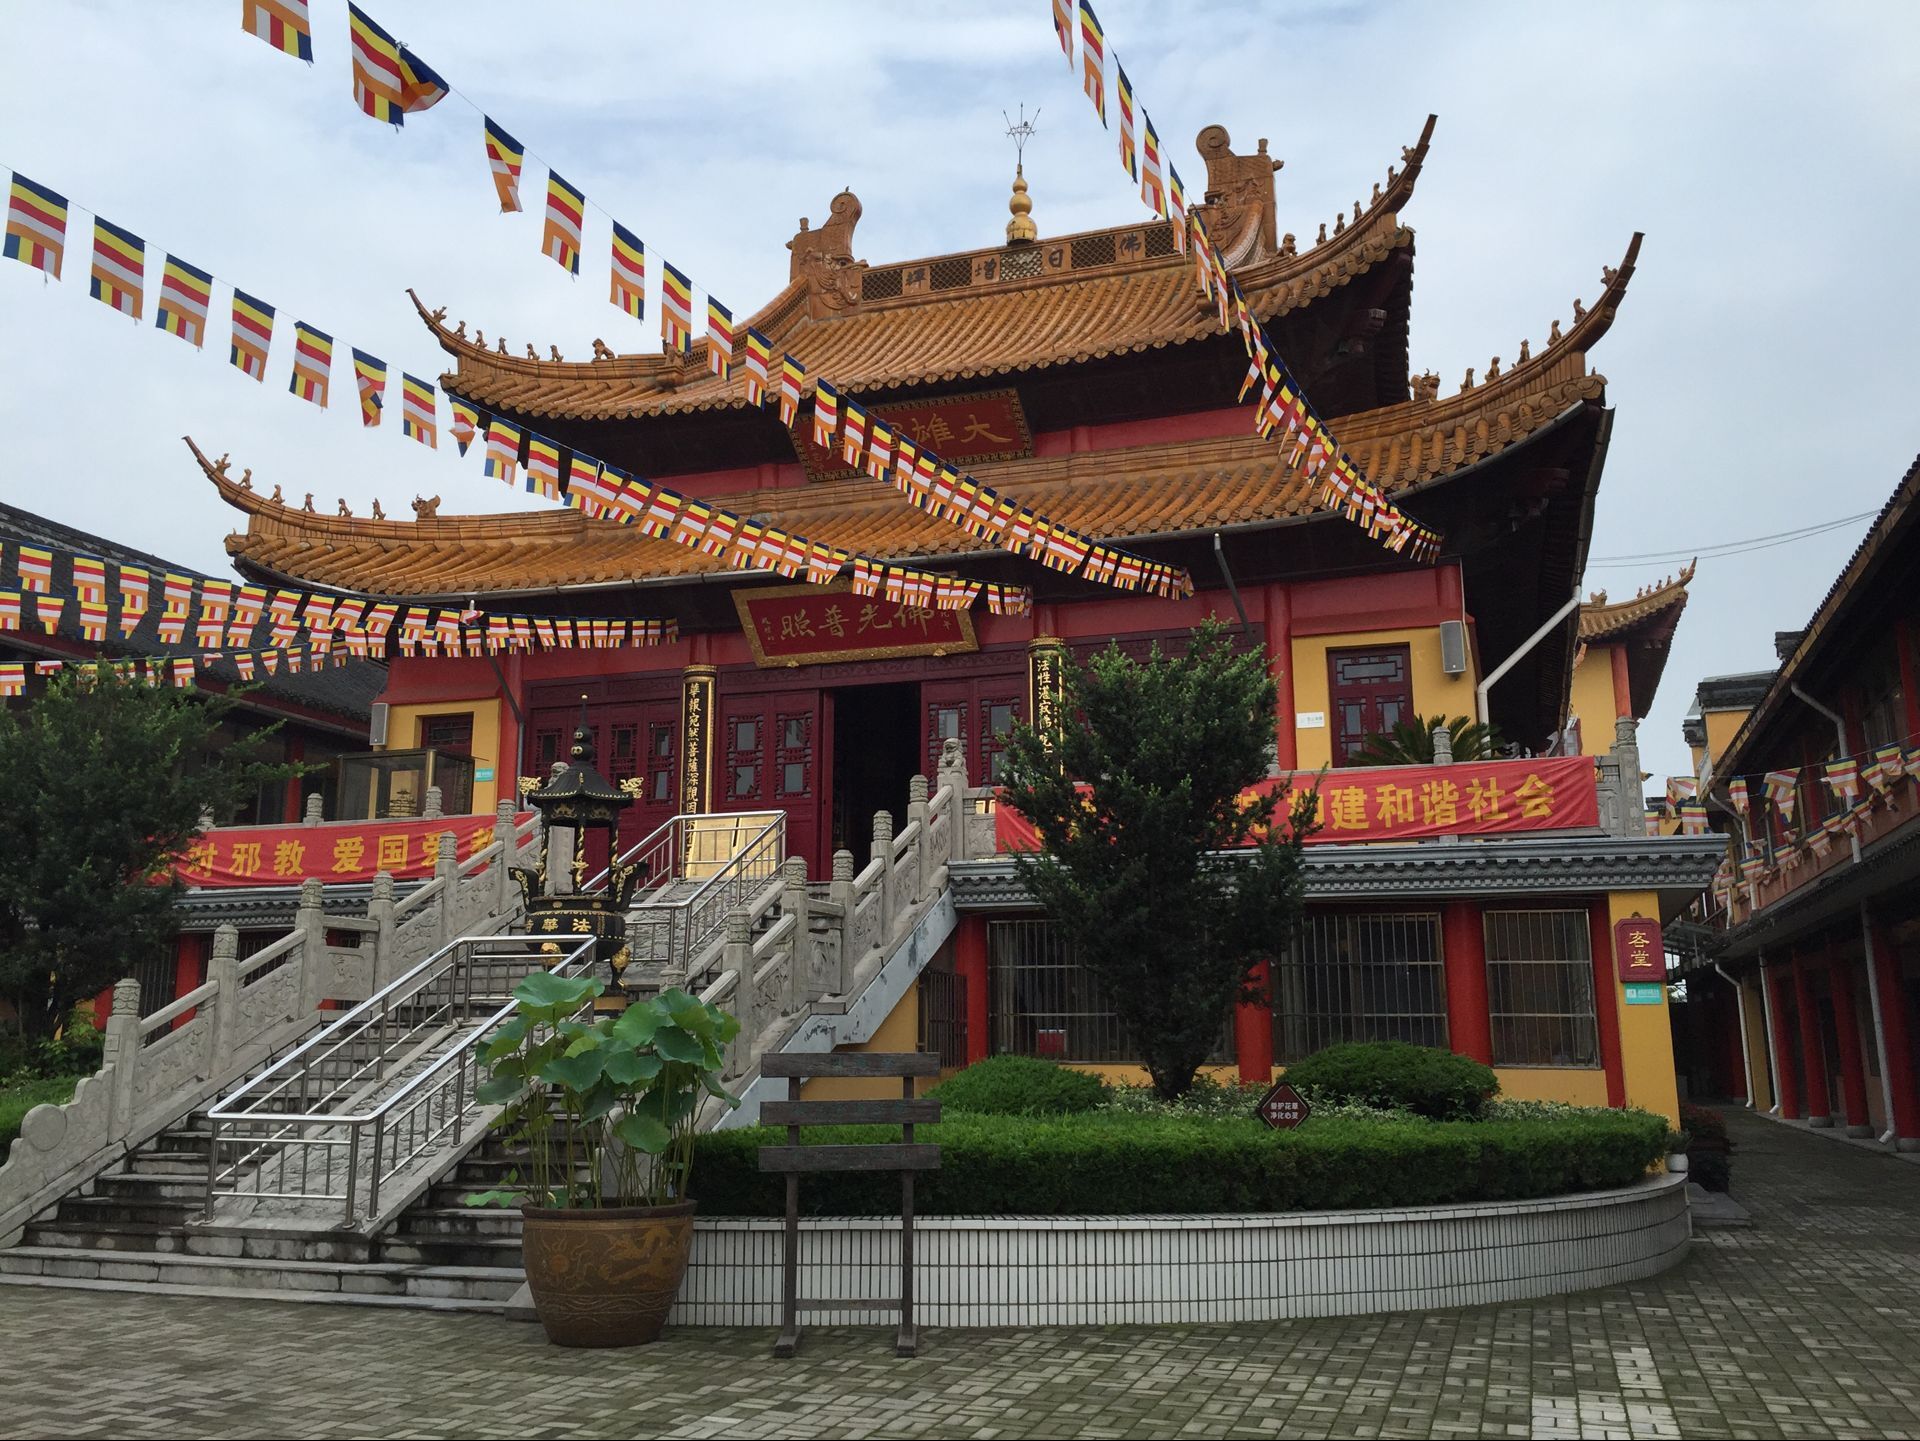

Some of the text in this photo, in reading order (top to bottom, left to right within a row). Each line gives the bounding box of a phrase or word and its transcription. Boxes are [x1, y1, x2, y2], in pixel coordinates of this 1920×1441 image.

[1287, 773, 1555, 831] 构建和谐社会
[150, 839, 306, 878] 对邪教
[1628, 931, 1652, 968] 客堂
